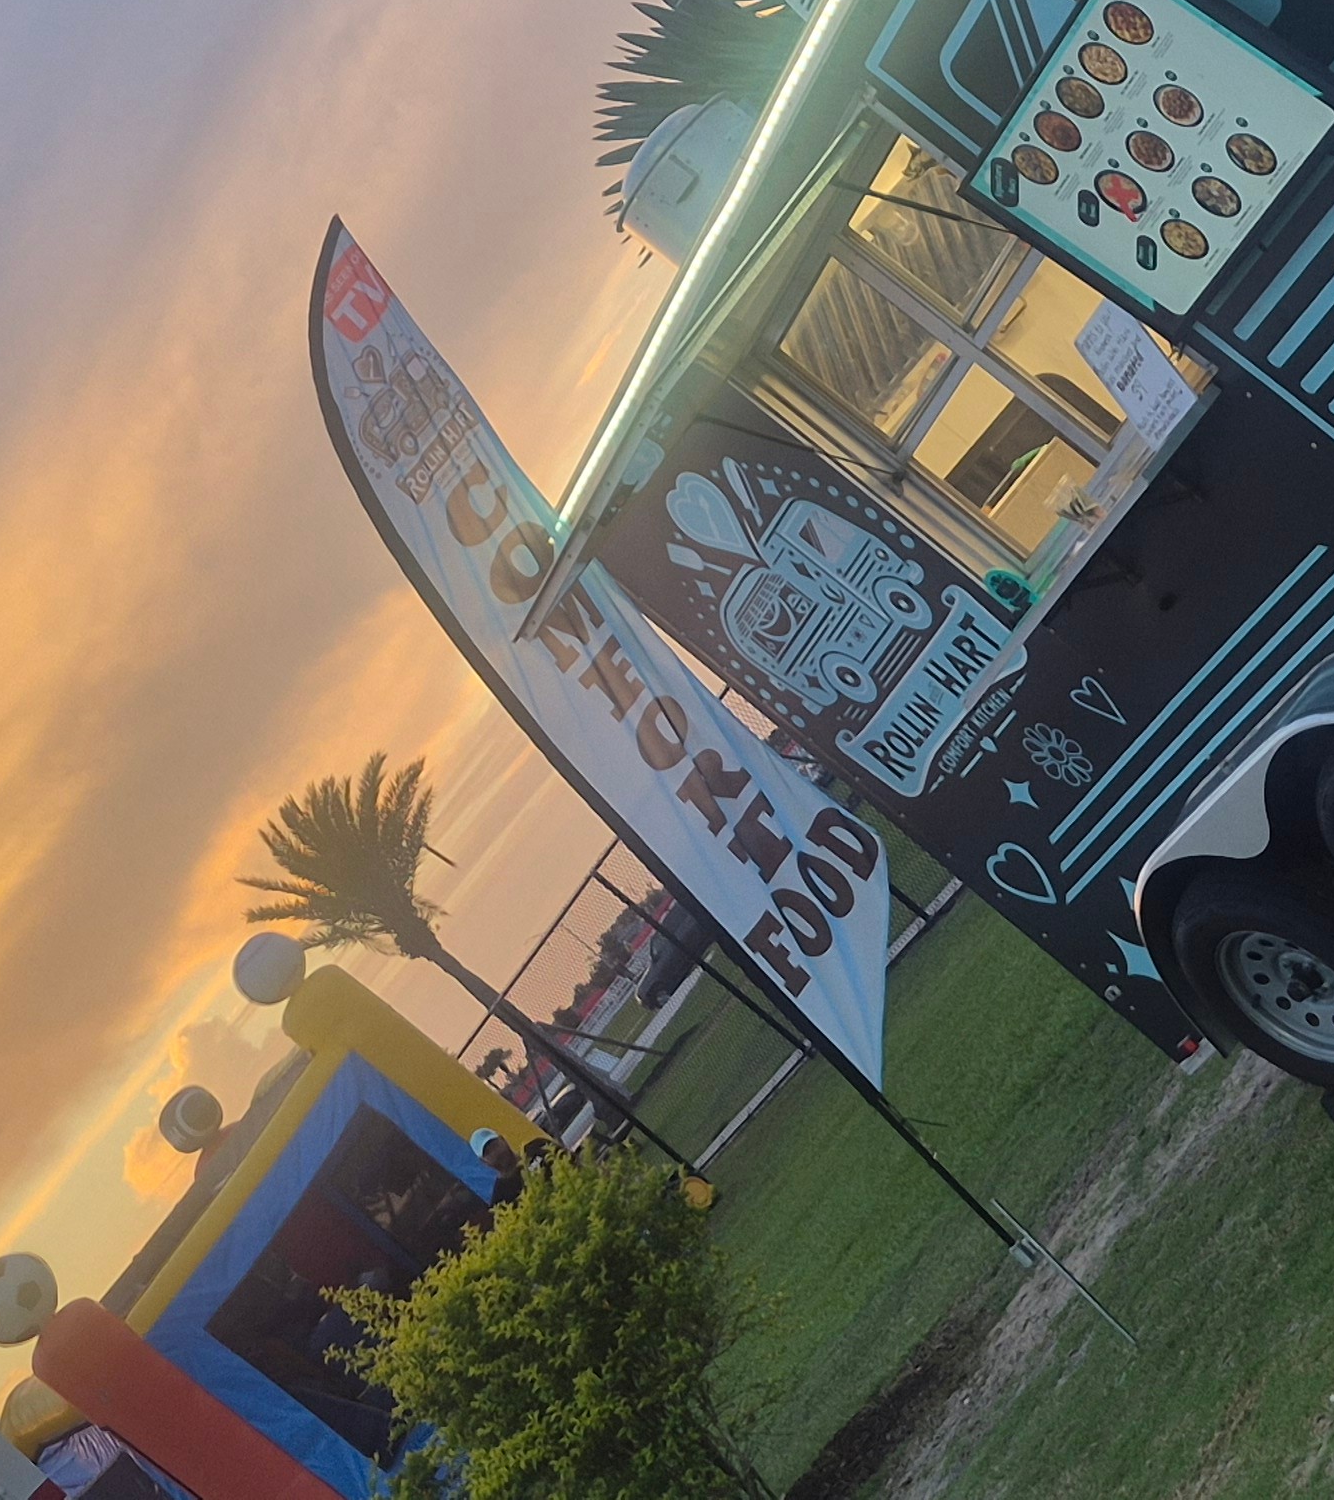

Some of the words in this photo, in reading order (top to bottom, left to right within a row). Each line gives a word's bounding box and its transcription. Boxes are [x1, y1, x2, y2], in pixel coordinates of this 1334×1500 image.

[331, 264, 386, 330] TV
[406, 445, 448, 499] ROLLIN
[863, 691, 945, 781] ROLLIN
[923, 612, 1002, 700] HART
[938, 723, 978, 775] COMFORT
[973, 688, 1013, 730] KITCHEN
[745, 805, 879, 999] FOOD
